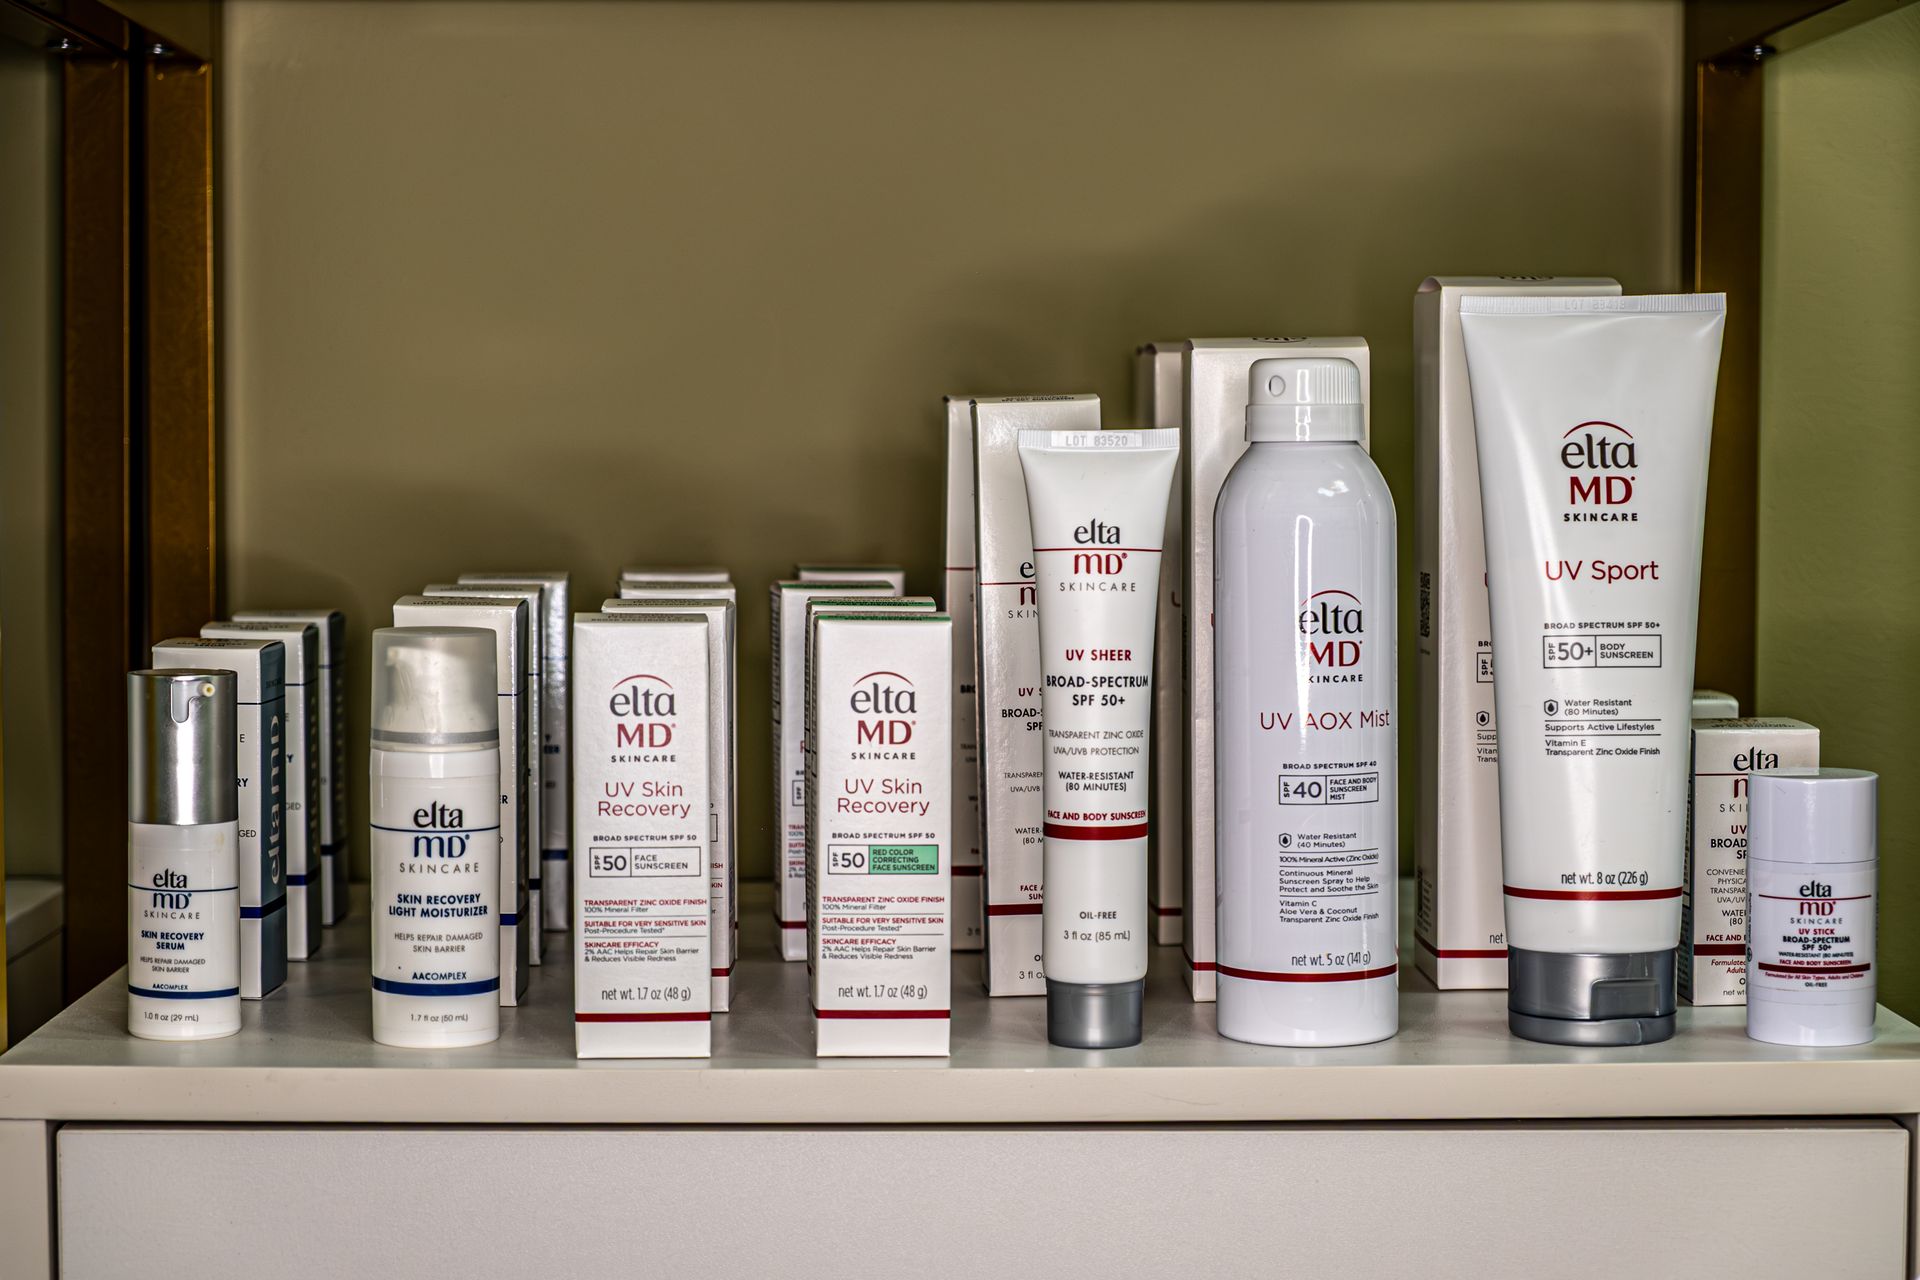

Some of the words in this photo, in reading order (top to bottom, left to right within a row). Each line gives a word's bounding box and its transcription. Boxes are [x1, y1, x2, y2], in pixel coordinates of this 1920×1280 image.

[1066, 435, 1086, 446] LOT
[1561, 432, 1638, 469] elta
[1564, 513, 1637, 521] SKINCARE
[1074, 519, 1120, 544] elta
[1546, 561, 1582, 580] UV
[1592, 560, 1659, 584] Sport
[1060, 582, 1135, 592] SKINCARE
[1299, 601, 1363, 634] elta
[1066, 650, 1084, 661] UV
[1091, 650, 1131, 661] SHEER
[1558, 642, 1593, 660] 50+
[1046, 675, 1148, 687] BROAD-SPECTRUM
[610, 684, 676, 716] elta
[851, 682, 917, 713] elta
[1073, 694, 1094, 706] SPF
[1101, 695, 1125, 706] 50+
[1565, 708, 1579, 716] (80
[1583, 708, 1618, 716] Minutes)
[1261, 712, 1292, 730] UV
[1307, 712, 1352, 730] AOX
[1361, 710, 1389, 728] Mist
[1545, 724, 1584, 732] Supports
[1617, 723, 1654, 731] Lifestyles
[1048, 729, 1099, 740] TRANSPARENT
[1104, 731, 1123, 739] ZINC
[1126, 730, 1144, 739] OXIDE
[852, 752, 915, 760] SKINCARE
[1053, 746, 1087, 756] UVA/UVB
[1091, 746, 1139, 755] PROTECTION
[611, 755, 675, 763] SKINCARE
[1733, 747, 1778, 771] elta
[1058, 771, 1134, 780] WATER-RESISTANT
[606, 782, 634, 797] UV
[643, 782, 682, 797] Skin
[846, 779, 874, 794] UV
[882, 779, 922, 794] Skin
[1066, 782, 1079, 792] (80
[1083, 782, 1126, 792] MINUTES)
[1293, 782, 1322, 798] 40
[1330, 785, 1367, 793] SUNSCREEN
[598, 801, 690, 819] Recovery
[838, 798, 929, 816] Recovery
[413, 801, 463, 828] elta
[1047, 809, 1060, 819] FACE
[1062, 812, 1079, 820] AND
[1111, 810, 1146, 820] SUNSCREEN
[1731, 825, 1747, 834] UV
[603, 856, 626, 871] 50
[841, 853, 865, 868] 50
[400, 862, 478, 873] SKINCARE
[153, 868, 187, 888] elta
[1561, 873, 1576, 884] net
[1579, 873, 1594, 884] wt.
[1597, 872, 1603, 884] 8
[1605, 875, 1615, 884] oz
[1618, 871, 1637, 886] (226
[1640, 871, 1648, 886] g)
[1800, 880, 1831, 897] elta
[398, 894, 421, 904] SKIN
[427, 893, 480, 904] RECOVERY
[144, 910, 199, 919] SKINCARE
[389, 906, 416, 917] LIGHT
[421, 906, 487, 917] MOISTURIZER
[1080, 911, 1116, 919] OIL-FREE
[141, 930, 157, 939] SKIN
[393, 932, 414, 941] HELPS
[446, 932, 483, 941] DAMAGED
[140, 956, 153, 965] HELPS
[412, 972, 466, 980] AACOMPLEX
